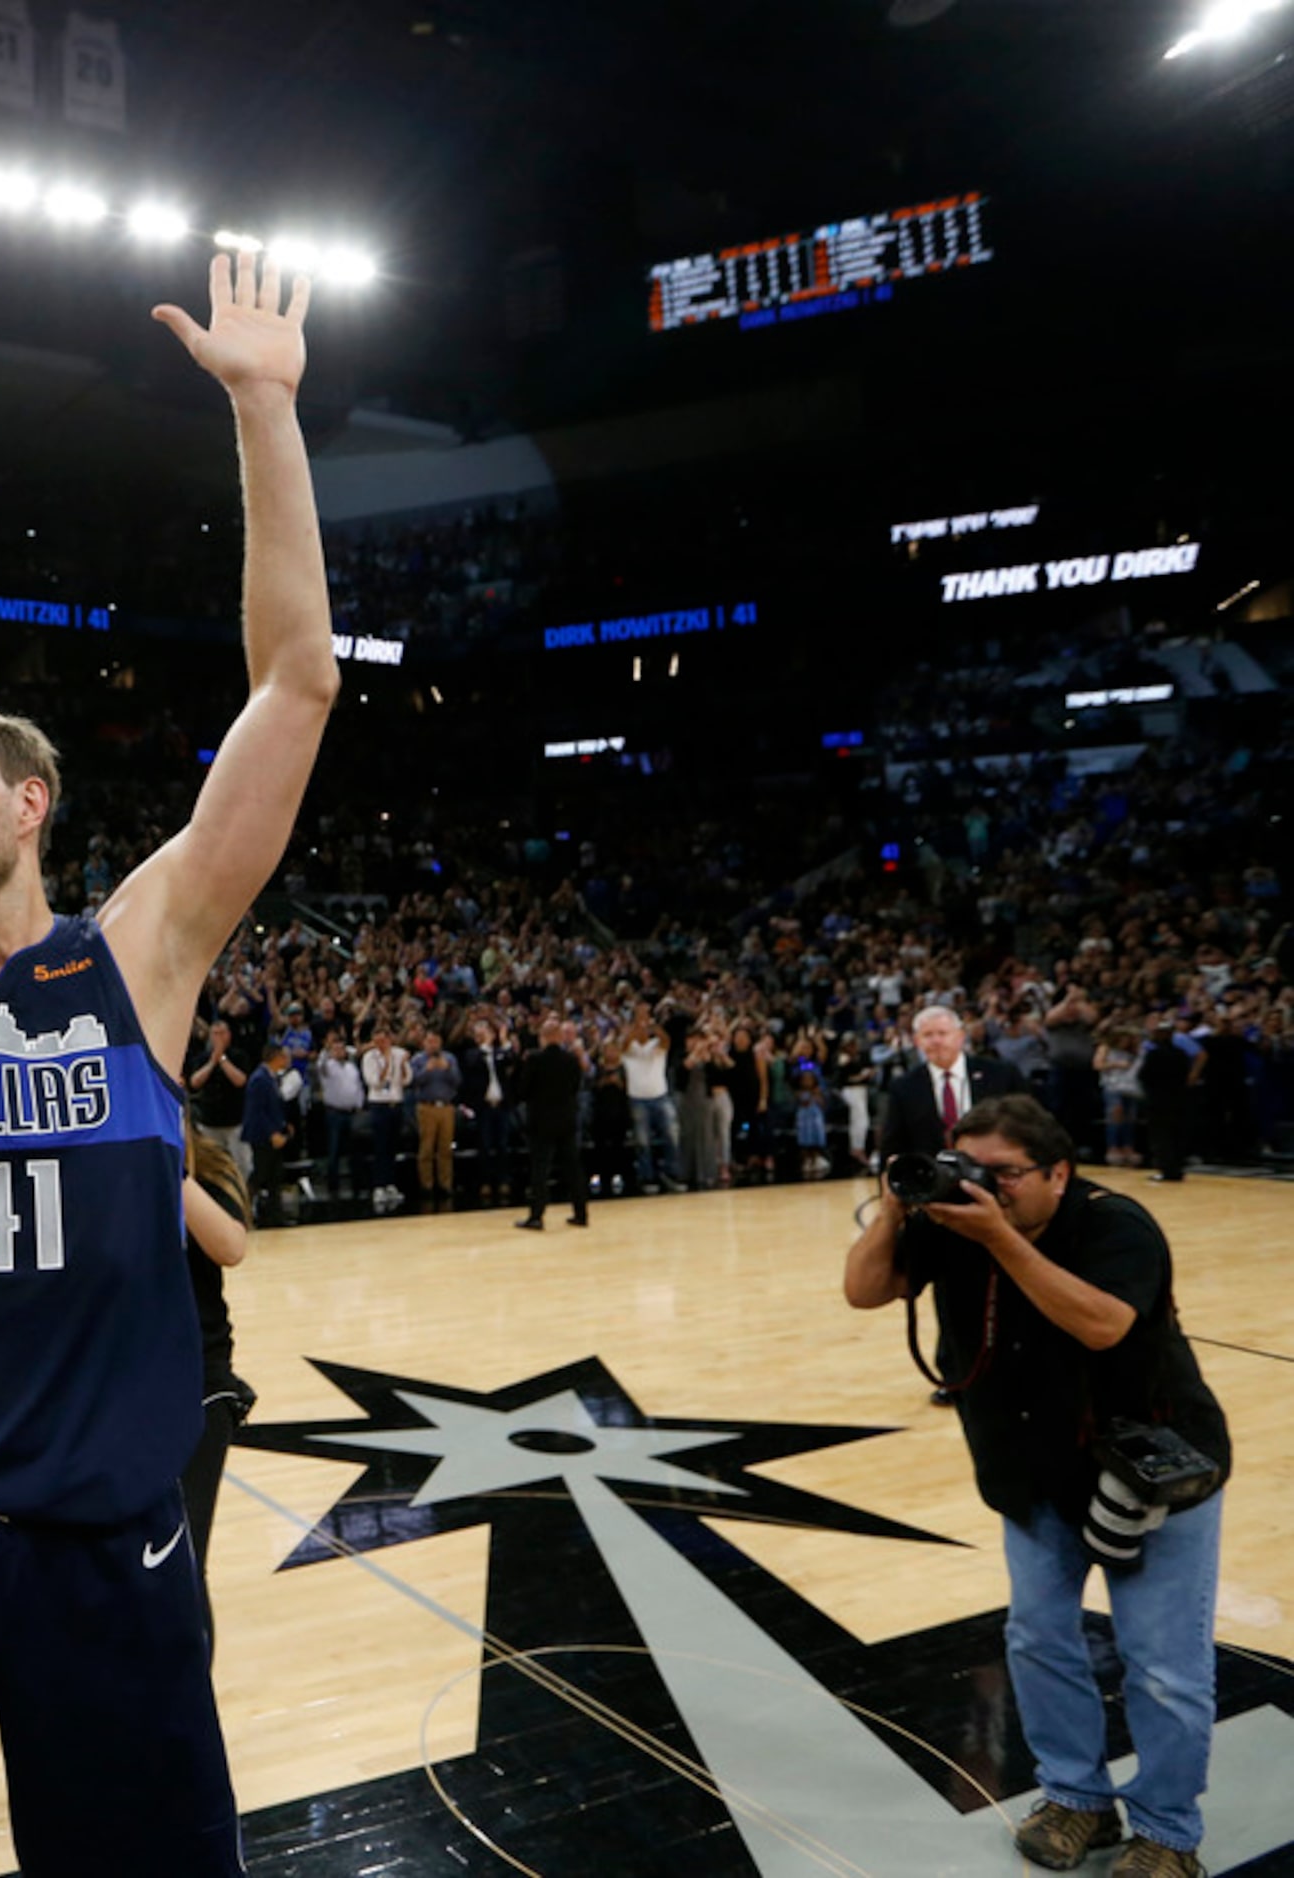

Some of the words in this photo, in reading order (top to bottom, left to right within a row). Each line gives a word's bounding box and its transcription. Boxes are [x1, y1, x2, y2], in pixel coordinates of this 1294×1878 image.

[939, 563, 1041, 604] THANK
[1043, 555, 1110, 590] YOU
[1111, 543, 1201, 581] DIRK!
[86, 606, 111, 631] 41
[544, 622, 595, 649] DIRK
[599, 607, 710, 643] NOWITZKI
[730, 601, 757, 626] 41
